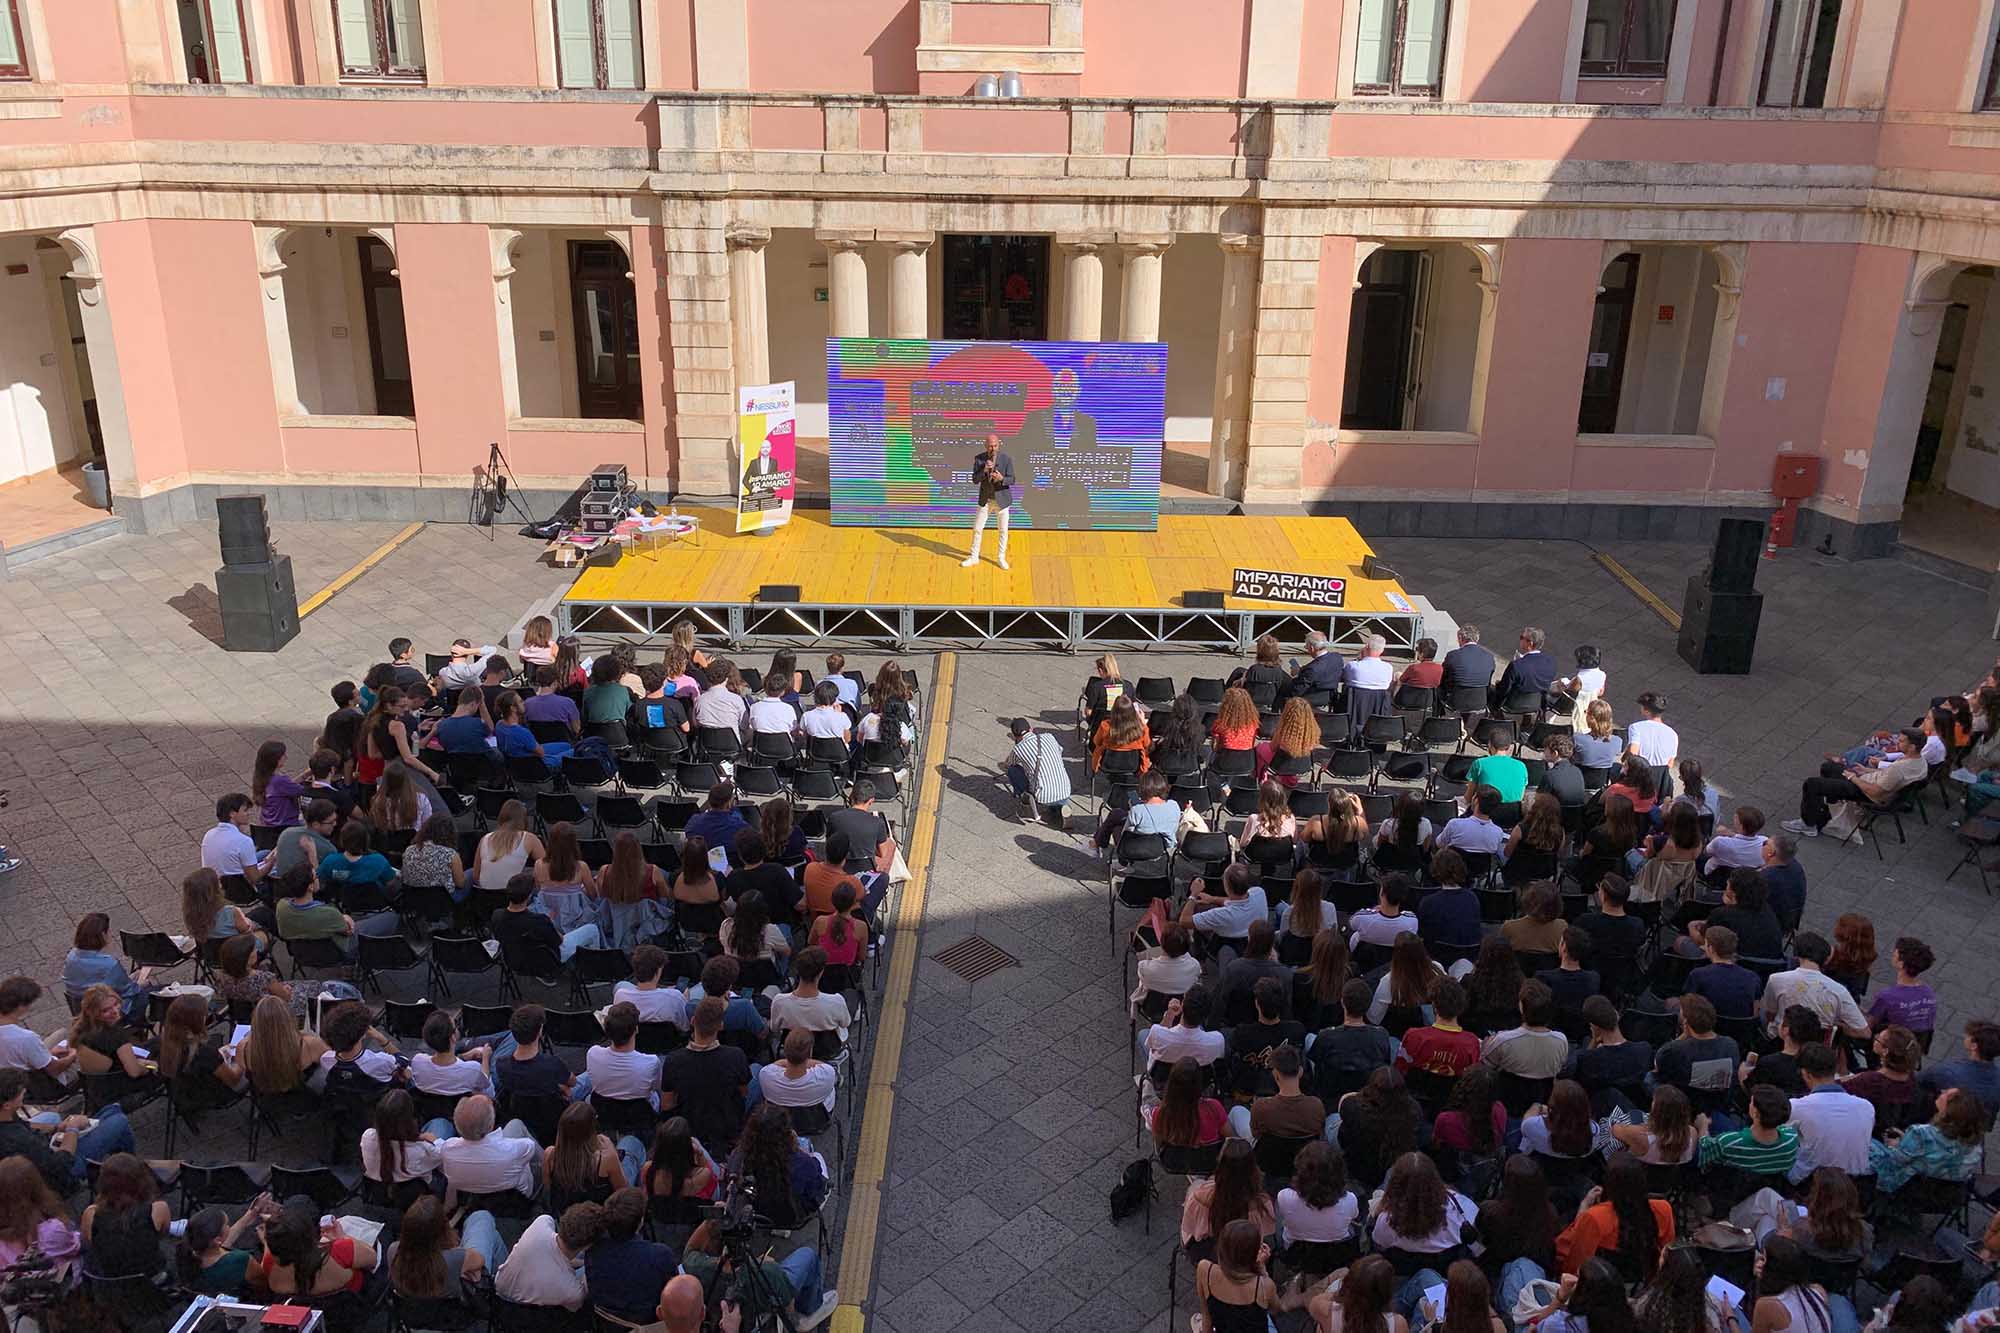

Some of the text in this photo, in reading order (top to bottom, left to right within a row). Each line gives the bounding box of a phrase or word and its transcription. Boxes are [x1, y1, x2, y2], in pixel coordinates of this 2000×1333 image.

[1235, 570, 1344, 591] IMPARIAMO
[1236, 583, 1342, 604] AD AMARCI
